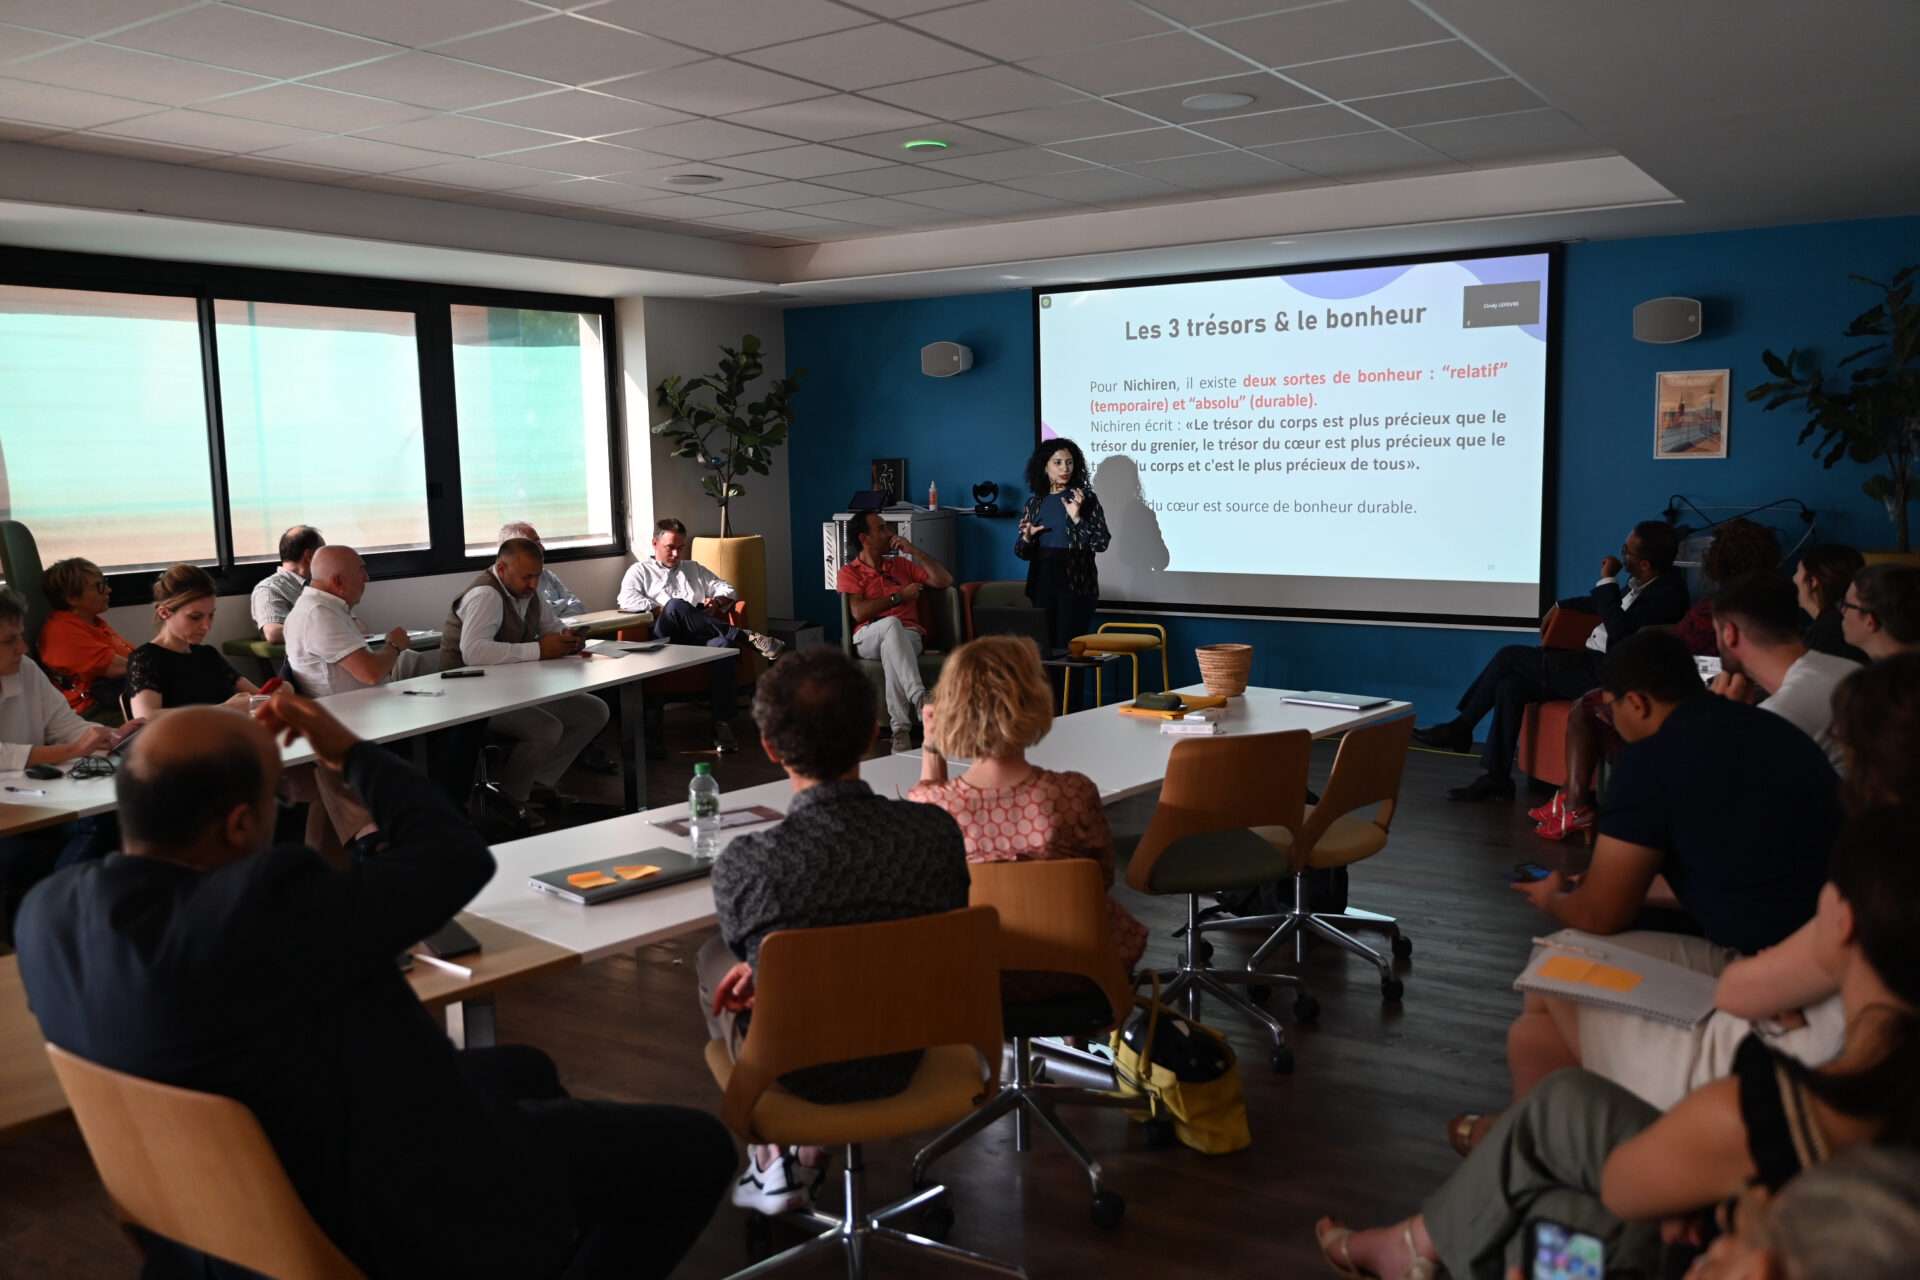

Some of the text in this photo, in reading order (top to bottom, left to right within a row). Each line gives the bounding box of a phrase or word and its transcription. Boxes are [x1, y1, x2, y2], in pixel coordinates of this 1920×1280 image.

[1125, 305, 1427, 341] Les 3 trésors & le bonheur
[1090, 380, 1118, 393] Pour
[1123, 379, 1180, 393] Nichiren,
[1186, 376, 1193, 389] il
[1199, 376, 1237, 389] existe
[1243, 374, 1276, 388] deux
[1282, 373, 1326, 387] sortes
[1333, 370, 1351, 384] de
[1358, 368, 1422, 383] bonheur
[1090, 399, 1169, 416] (temporaire)
[1172, 399, 1186, 411] et
[1250, 394, 1318, 411] (durable).
[1090, 420, 1140, 433] Nichiren
[1144, 418, 1172, 432] écrit
[1186, 418, 1209, 431] «Le
[1213, 417, 1253, 431] trésor
[1257, 416, 1275, 430] du
[1280, 417, 1318, 431] corps
[1322, 415, 1344, 428] est
[1349, 413, 1380, 430] plus
[1384, 411, 1450, 430] précieux
[1455, 412, 1486, 428] que
[1492, 409, 1507, 424] le
[1090, 432, 1506, 454] trésor du grenier, le trésor du cœur est plus précieux que le
[1150, 460, 1184, 475] corps
[1187, 459, 1201, 472] et
[1204, 458, 1235, 472] c'est
[1238, 458, 1250, 472] le
[1254, 458, 1282, 474] plus
[1286, 457, 1346, 474] précieux
[1350, 457, 1369, 471] de
[1373, 458, 1420, 471] tous».
[1166, 500, 1200, 512] cœur
[1203, 500, 1222, 512] est
[1225, 501, 1269, 513] source
[1273, 499, 1290, 513] de
[1294, 499, 1354, 514] bonheur
[1357, 500, 1417, 514] durable.
